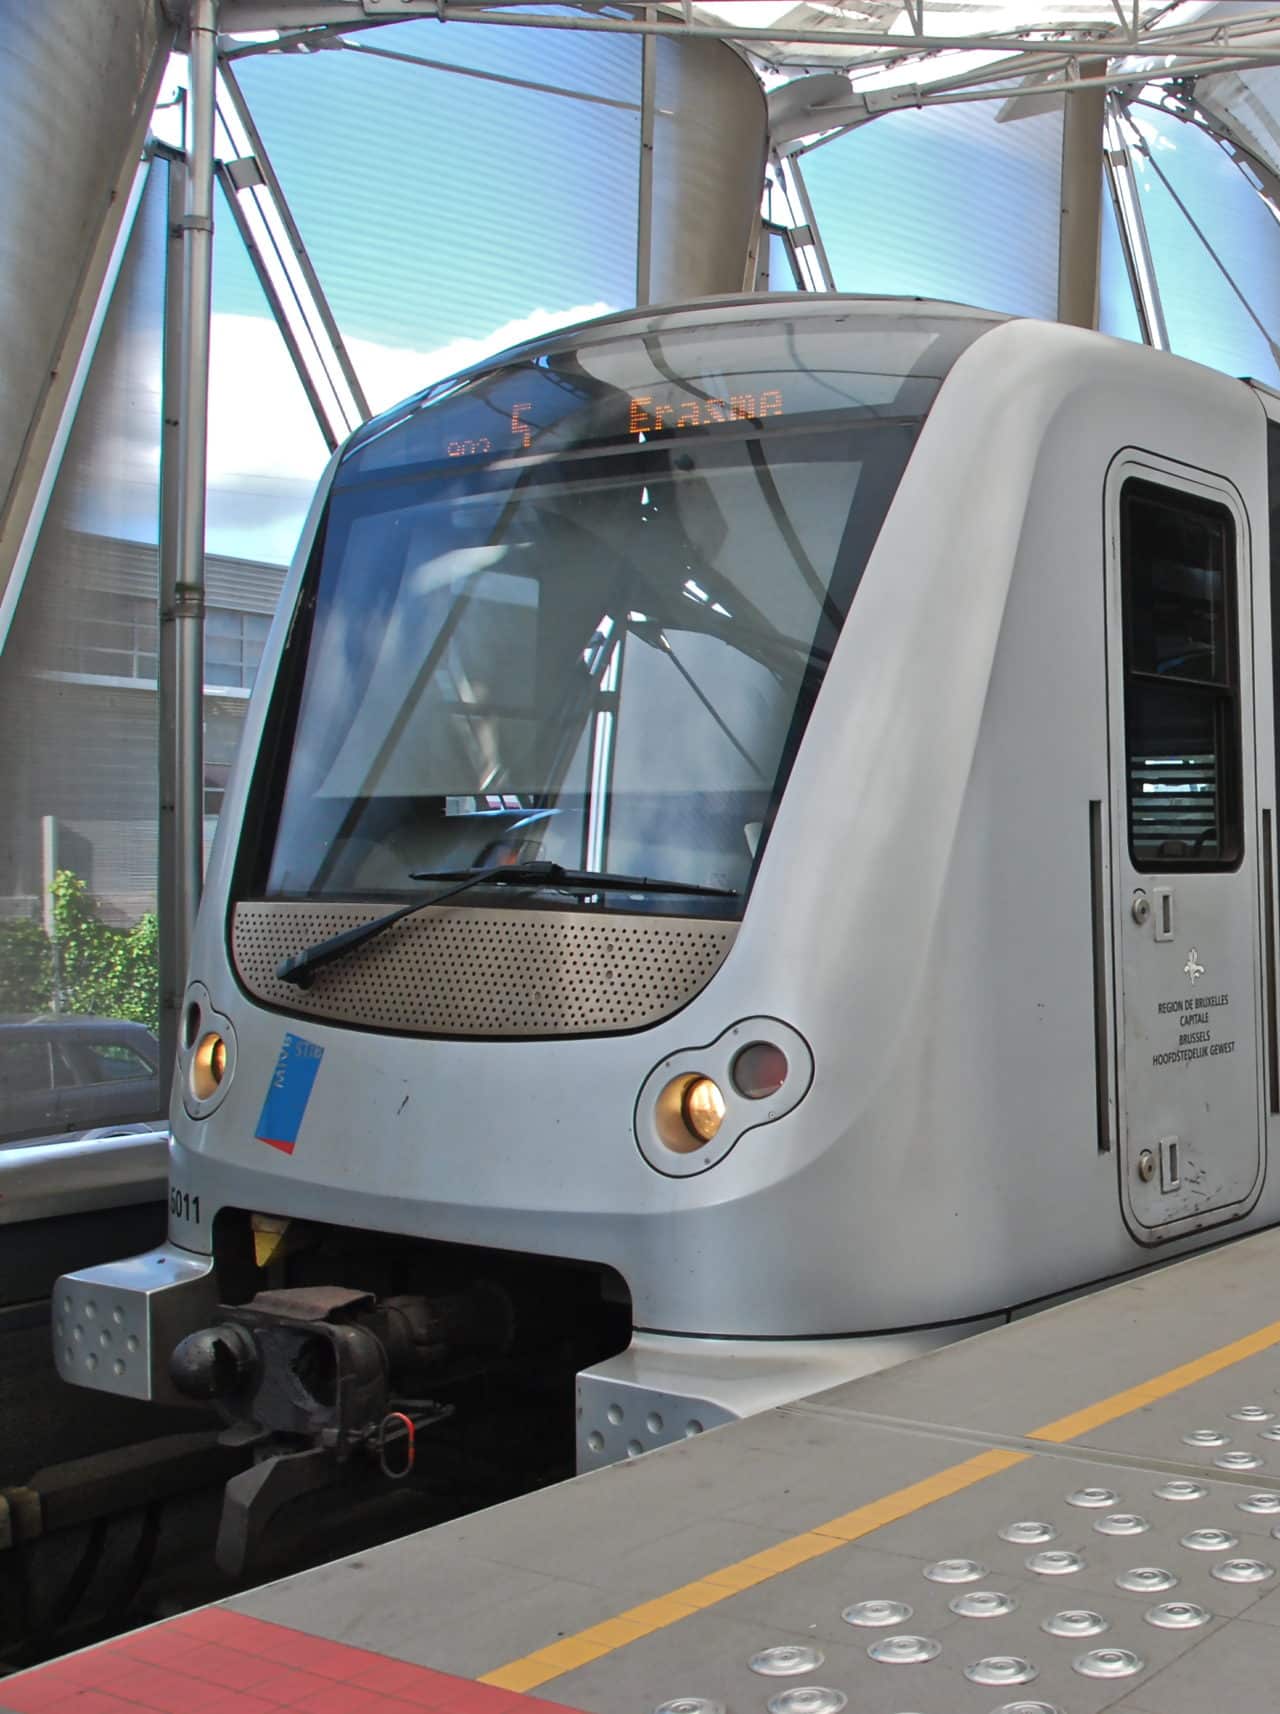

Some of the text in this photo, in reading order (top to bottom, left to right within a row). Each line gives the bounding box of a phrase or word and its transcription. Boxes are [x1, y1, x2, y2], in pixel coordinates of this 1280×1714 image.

[1184, 1000, 1193, 1010] DE
[1195, 994, 1228, 1009] BRUXELLES
[1180, 1012, 1208, 1026] CAPITALE
[1179, 1030, 1210, 1045] BRUSSELS
[1210, 1041, 1234, 1056] GEWEST
